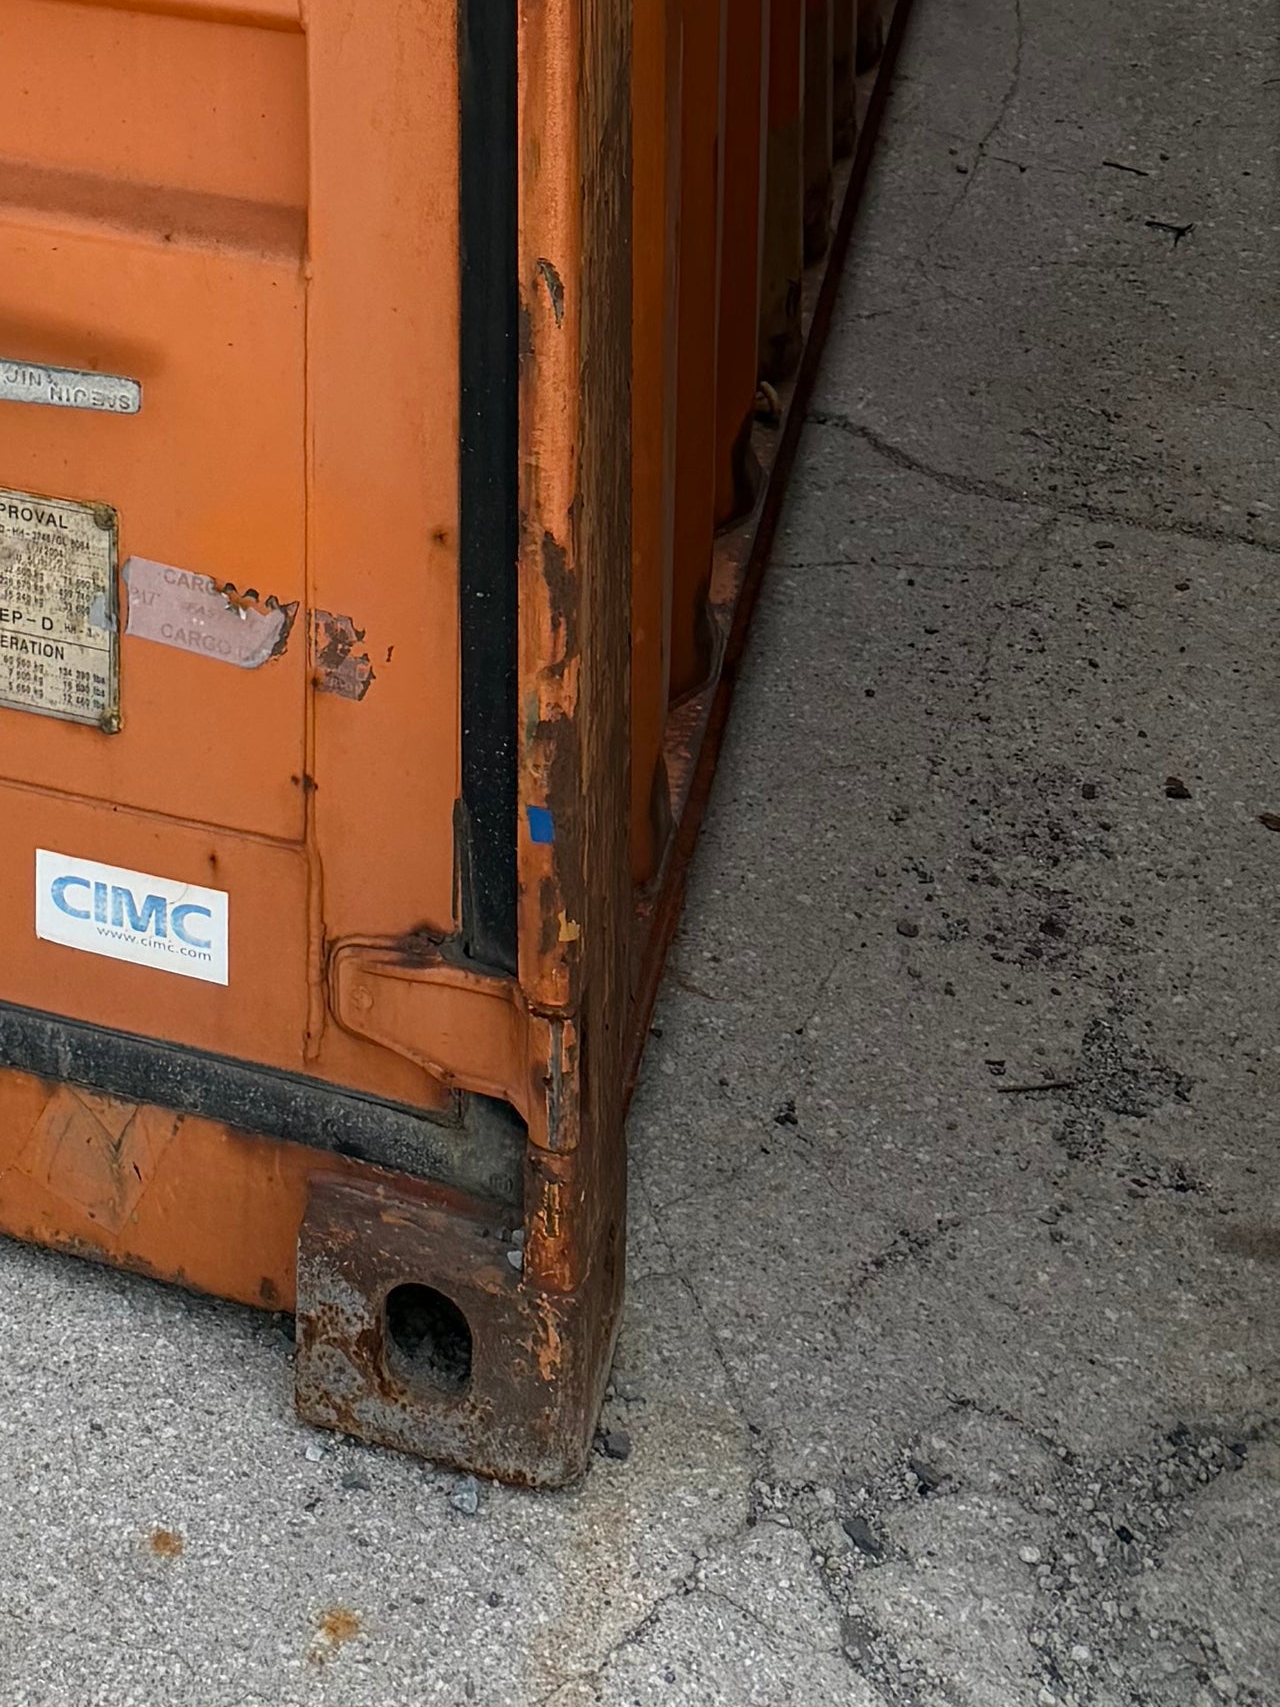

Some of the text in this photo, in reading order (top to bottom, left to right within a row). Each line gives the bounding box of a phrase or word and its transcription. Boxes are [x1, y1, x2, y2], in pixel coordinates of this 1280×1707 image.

[160, 622, 232, 656] CARGO
[50, 875, 212, 950] CIMC
[96, 926, 212, 962] www.cimc.com
